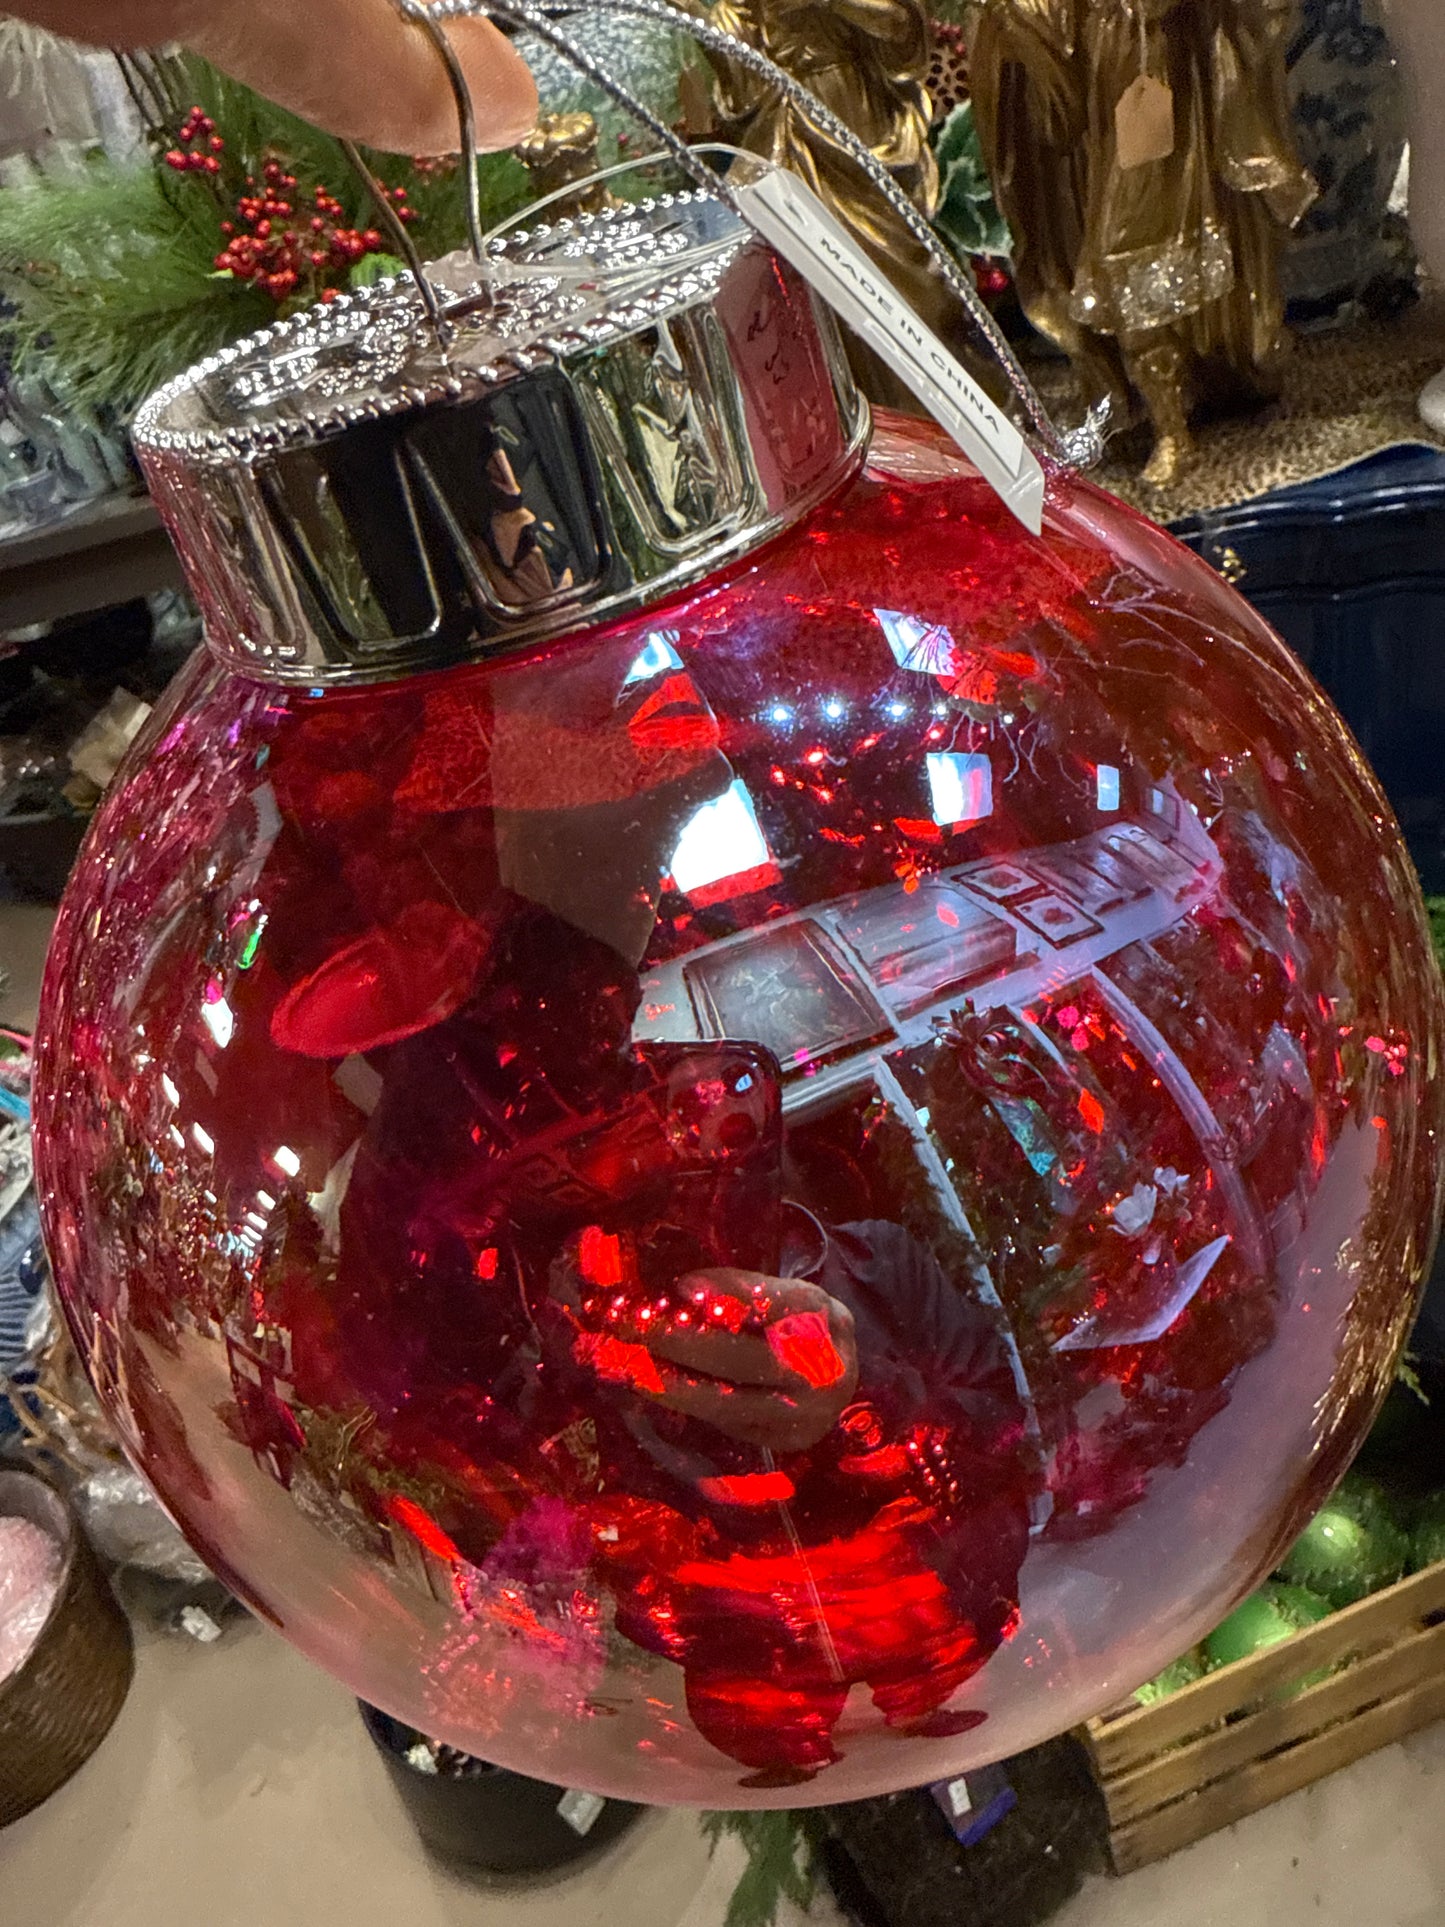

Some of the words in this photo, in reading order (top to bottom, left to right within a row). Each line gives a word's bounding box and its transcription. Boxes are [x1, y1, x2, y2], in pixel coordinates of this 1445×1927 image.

[821, 238, 894, 316] MADE
[900, 319, 923, 347] IN
[930, 352, 999, 434] CHINA
